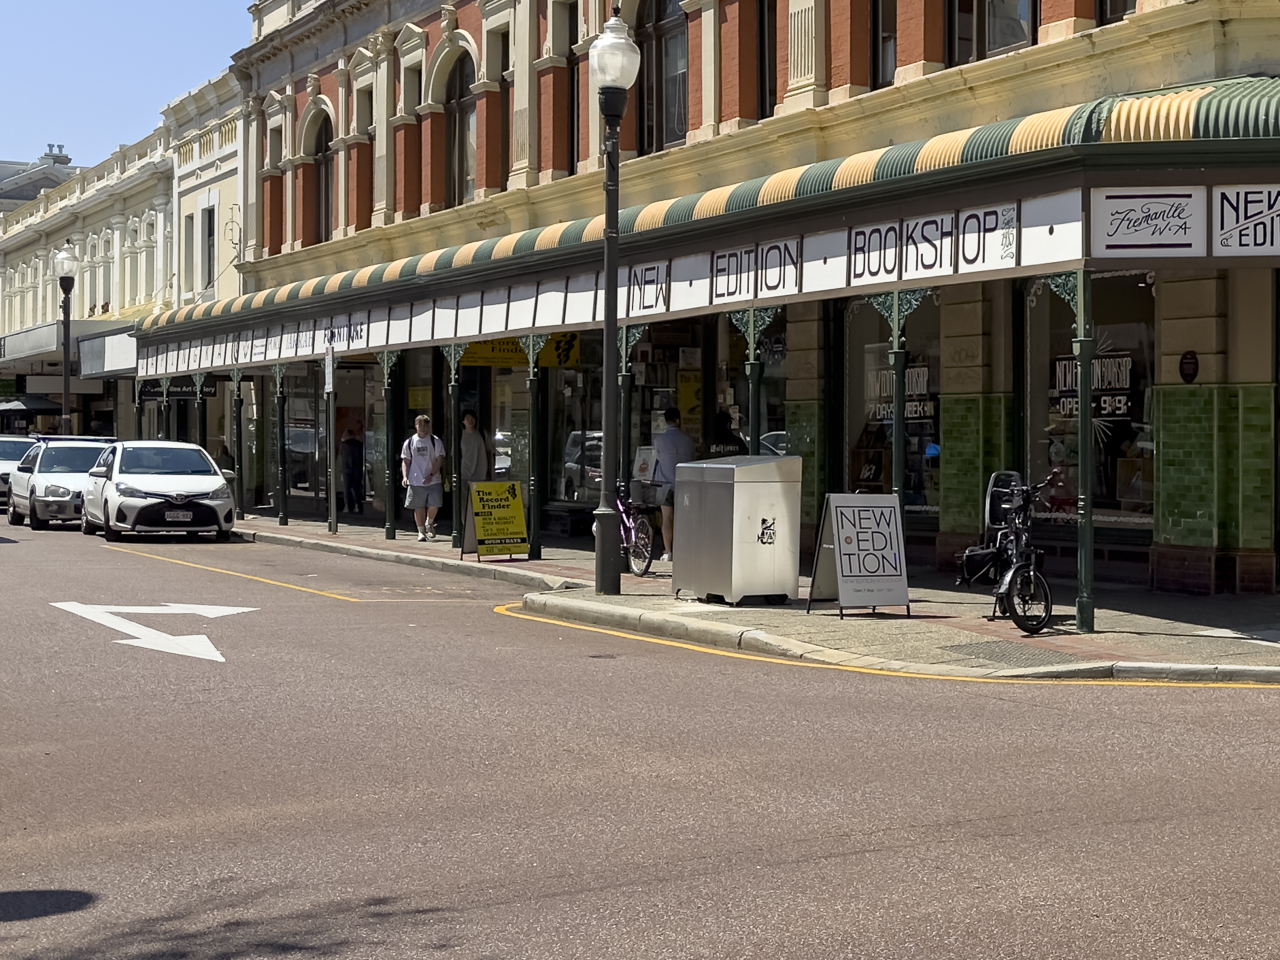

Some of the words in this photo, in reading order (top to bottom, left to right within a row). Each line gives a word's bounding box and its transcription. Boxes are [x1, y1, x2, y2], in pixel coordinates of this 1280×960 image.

[1106, 201, 1193, 237] Fremantle
[631, 264, 668, 312] NEW
[714, 240, 800, 299] EDITION
[853, 210, 999, 280] BOOKSHOP
[840, 509, 893, 530] NEW
[856, 530, 894, 552] EDI
[842, 552, 898, 574] TION
